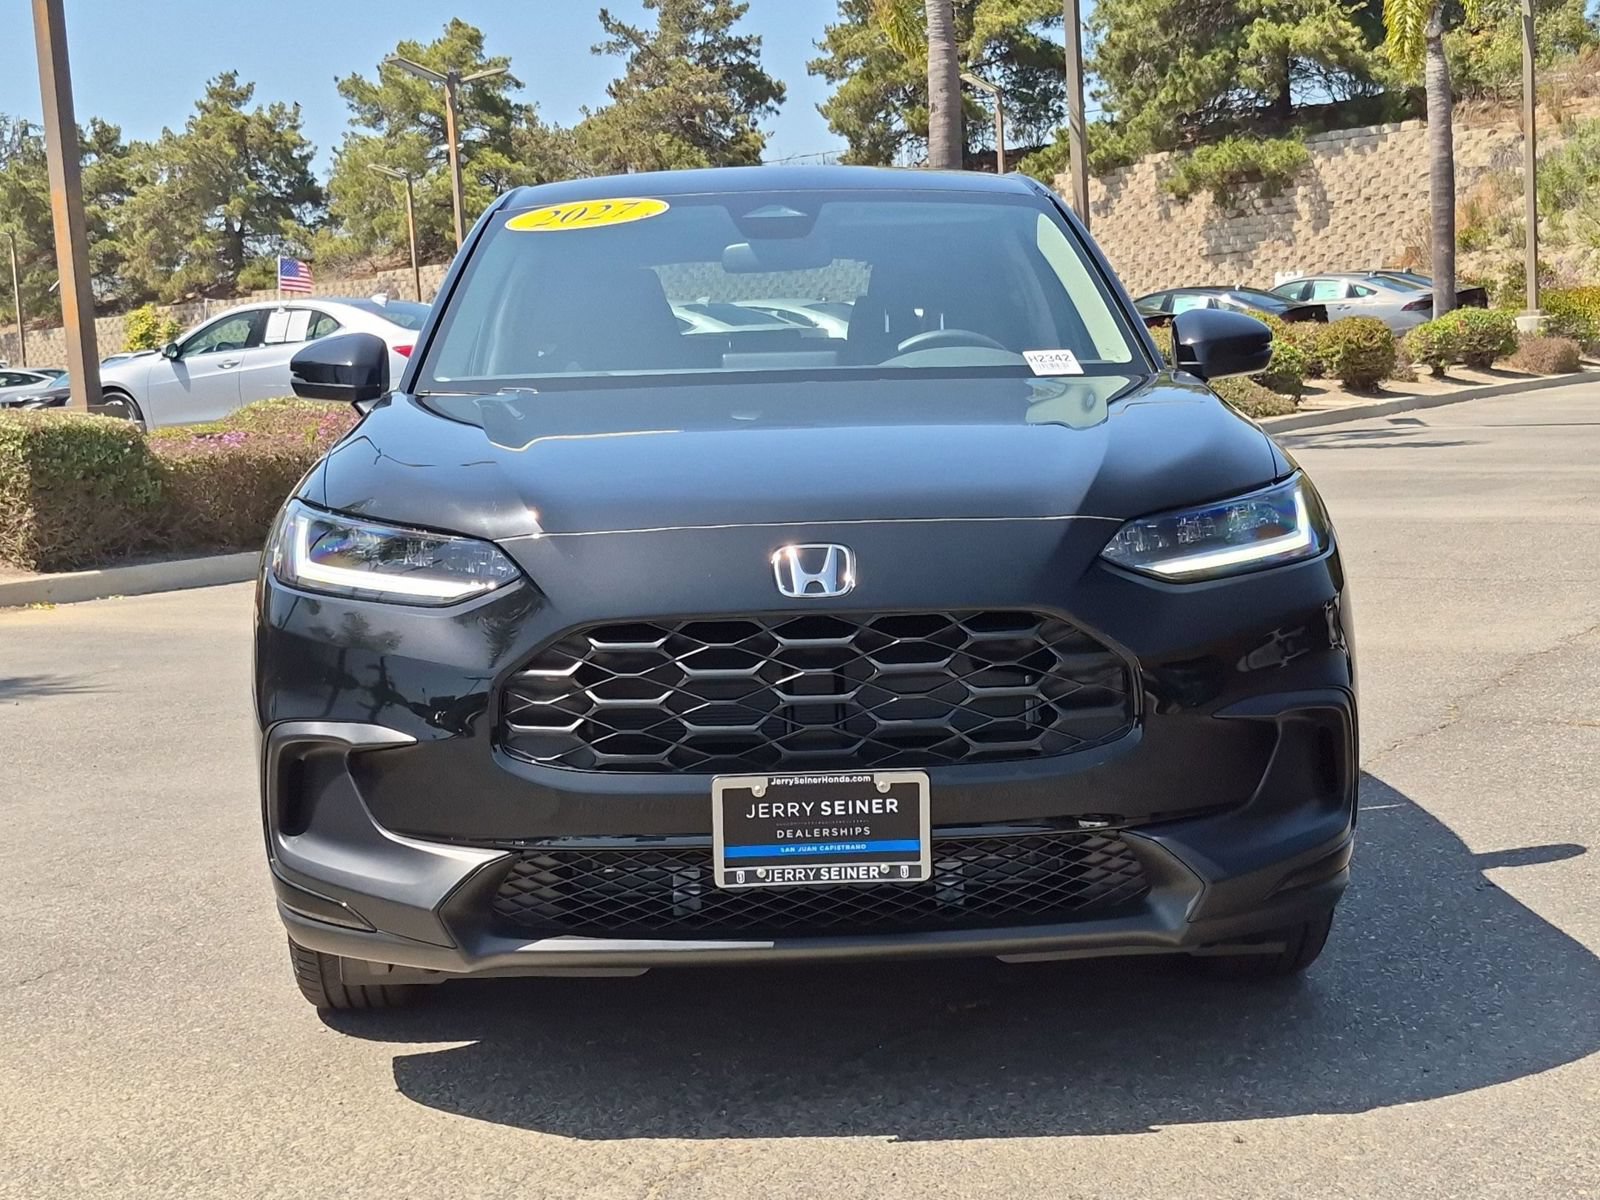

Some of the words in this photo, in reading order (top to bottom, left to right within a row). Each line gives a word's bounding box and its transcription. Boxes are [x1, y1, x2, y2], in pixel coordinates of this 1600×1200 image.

[529, 201, 641, 228] 2027
[771, 775, 871, 786] JerrySeinerHonda.com
[746, 801, 815, 819] JERRY
[820, 798, 899, 816] SEINER
[776, 826, 871, 839] DEALERSHIPS
[798, 845, 817, 853] JUAN
[819, 843, 867, 852] CAPISTRANO
[765, 868, 817, 882] JERRY
[820, 866, 880, 880] SEINER
